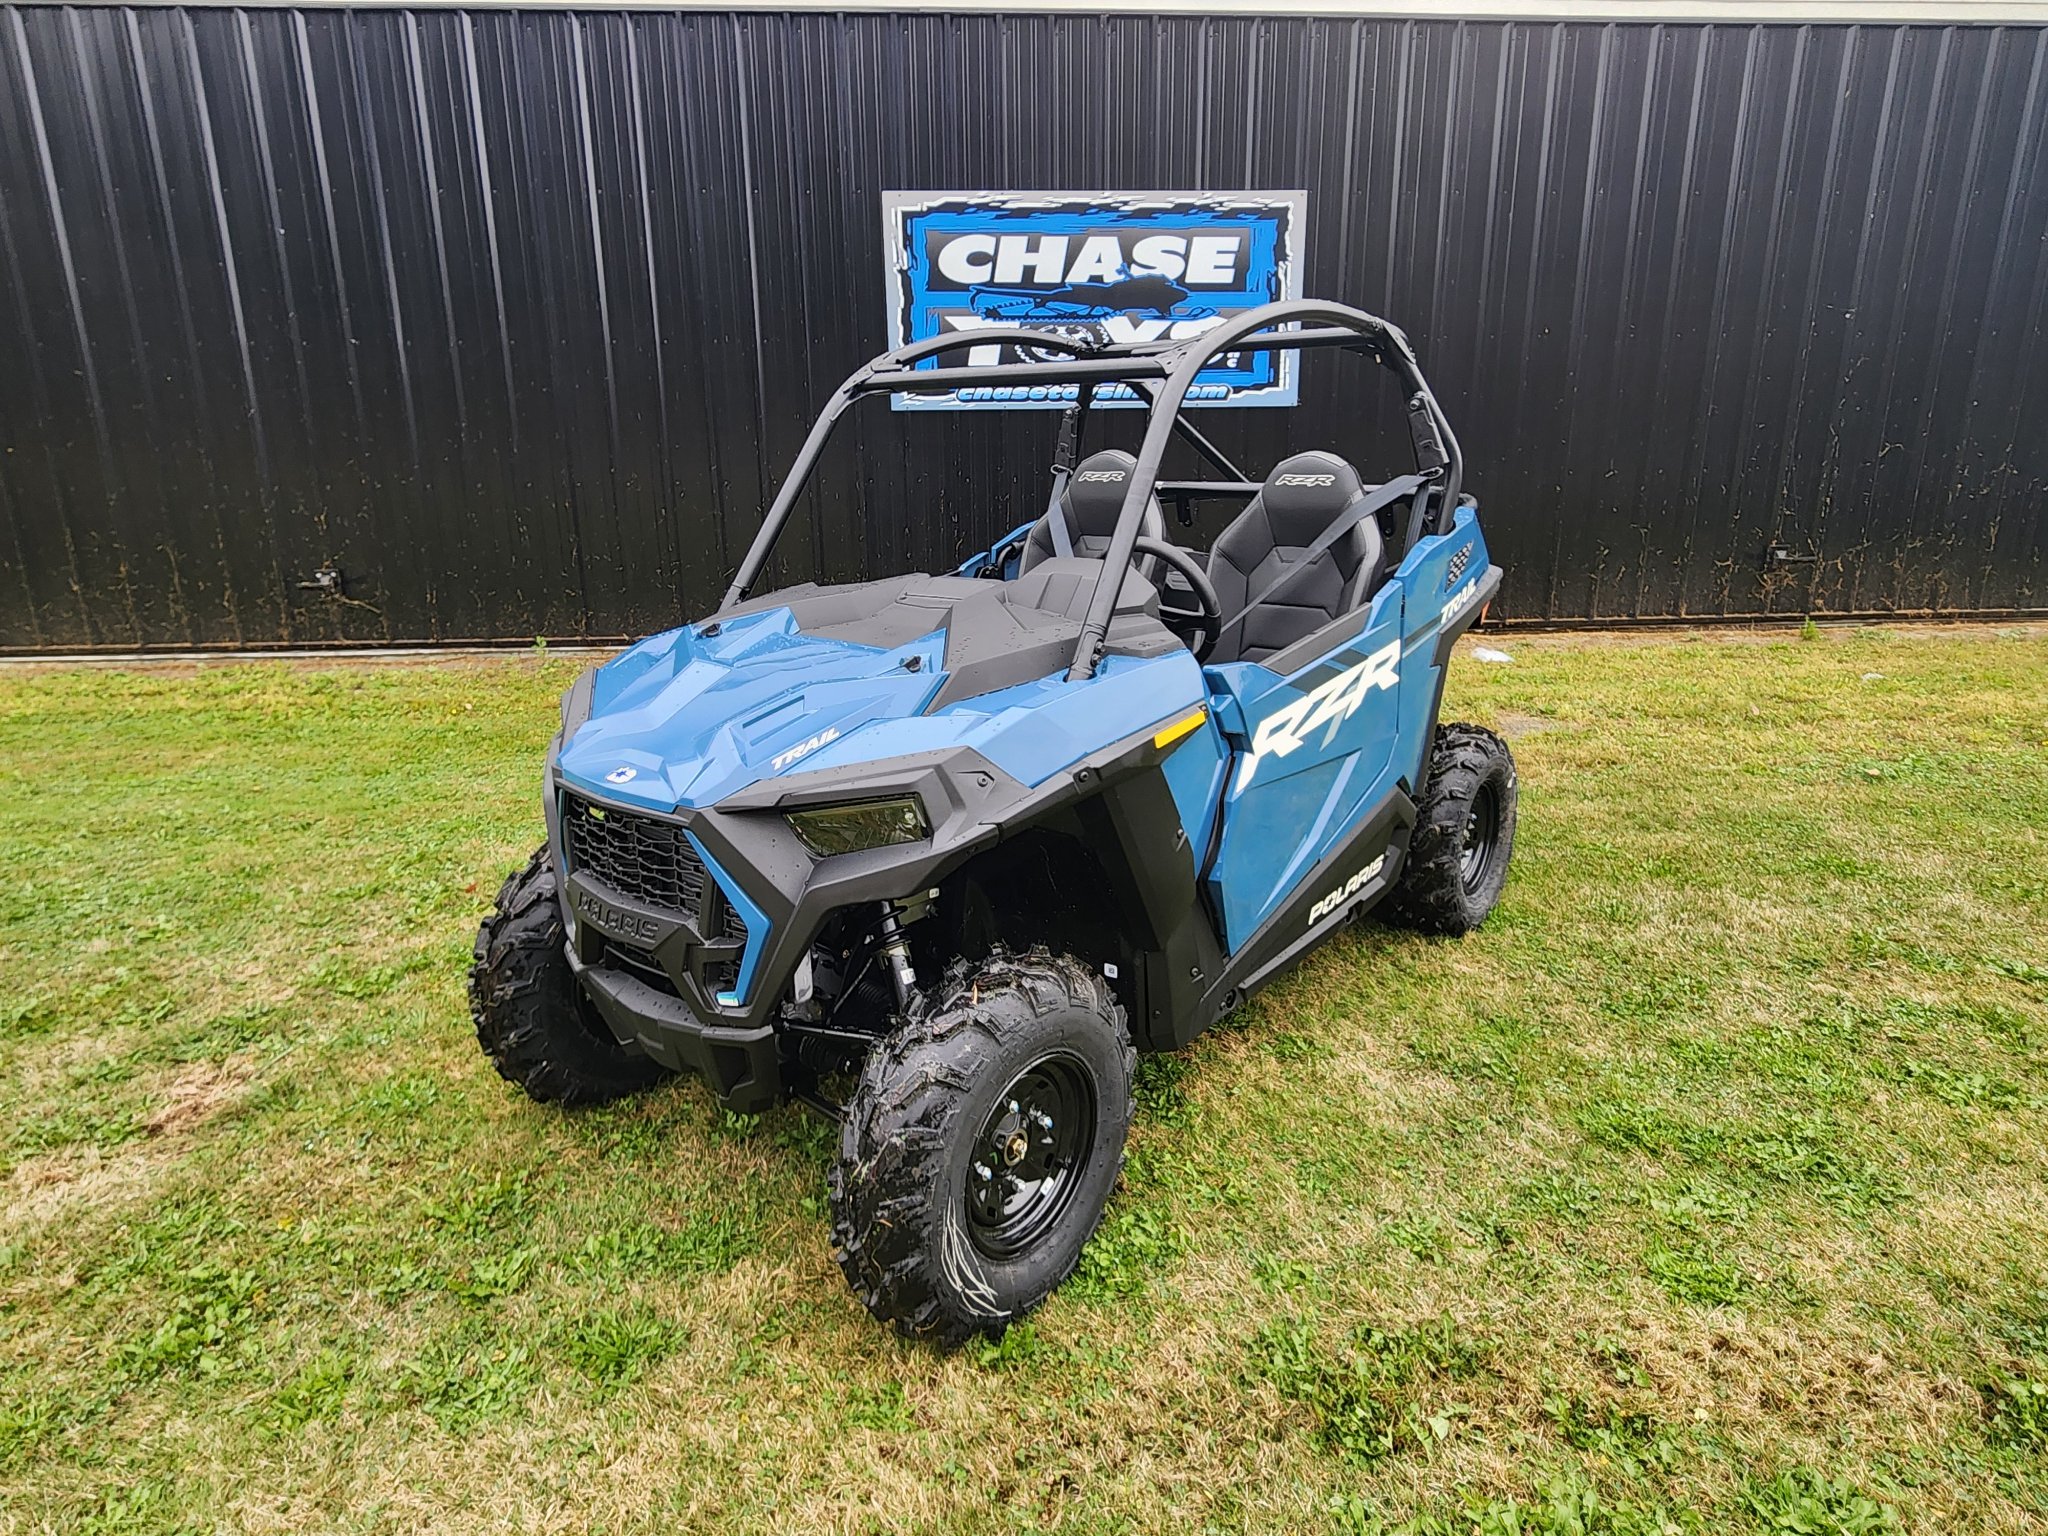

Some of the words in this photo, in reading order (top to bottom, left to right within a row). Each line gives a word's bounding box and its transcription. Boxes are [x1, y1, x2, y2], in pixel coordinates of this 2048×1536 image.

[937, 234, 1242, 285] CHASE
[1078, 470, 1126, 482] RZR
[1274, 473, 1336, 487] RZR
[1440, 576, 1478, 625] TRAIL
[1236, 638, 1402, 793] RZR
[770, 726, 841, 771] TRAIL
[1307, 853, 1385, 926] POLARIS
